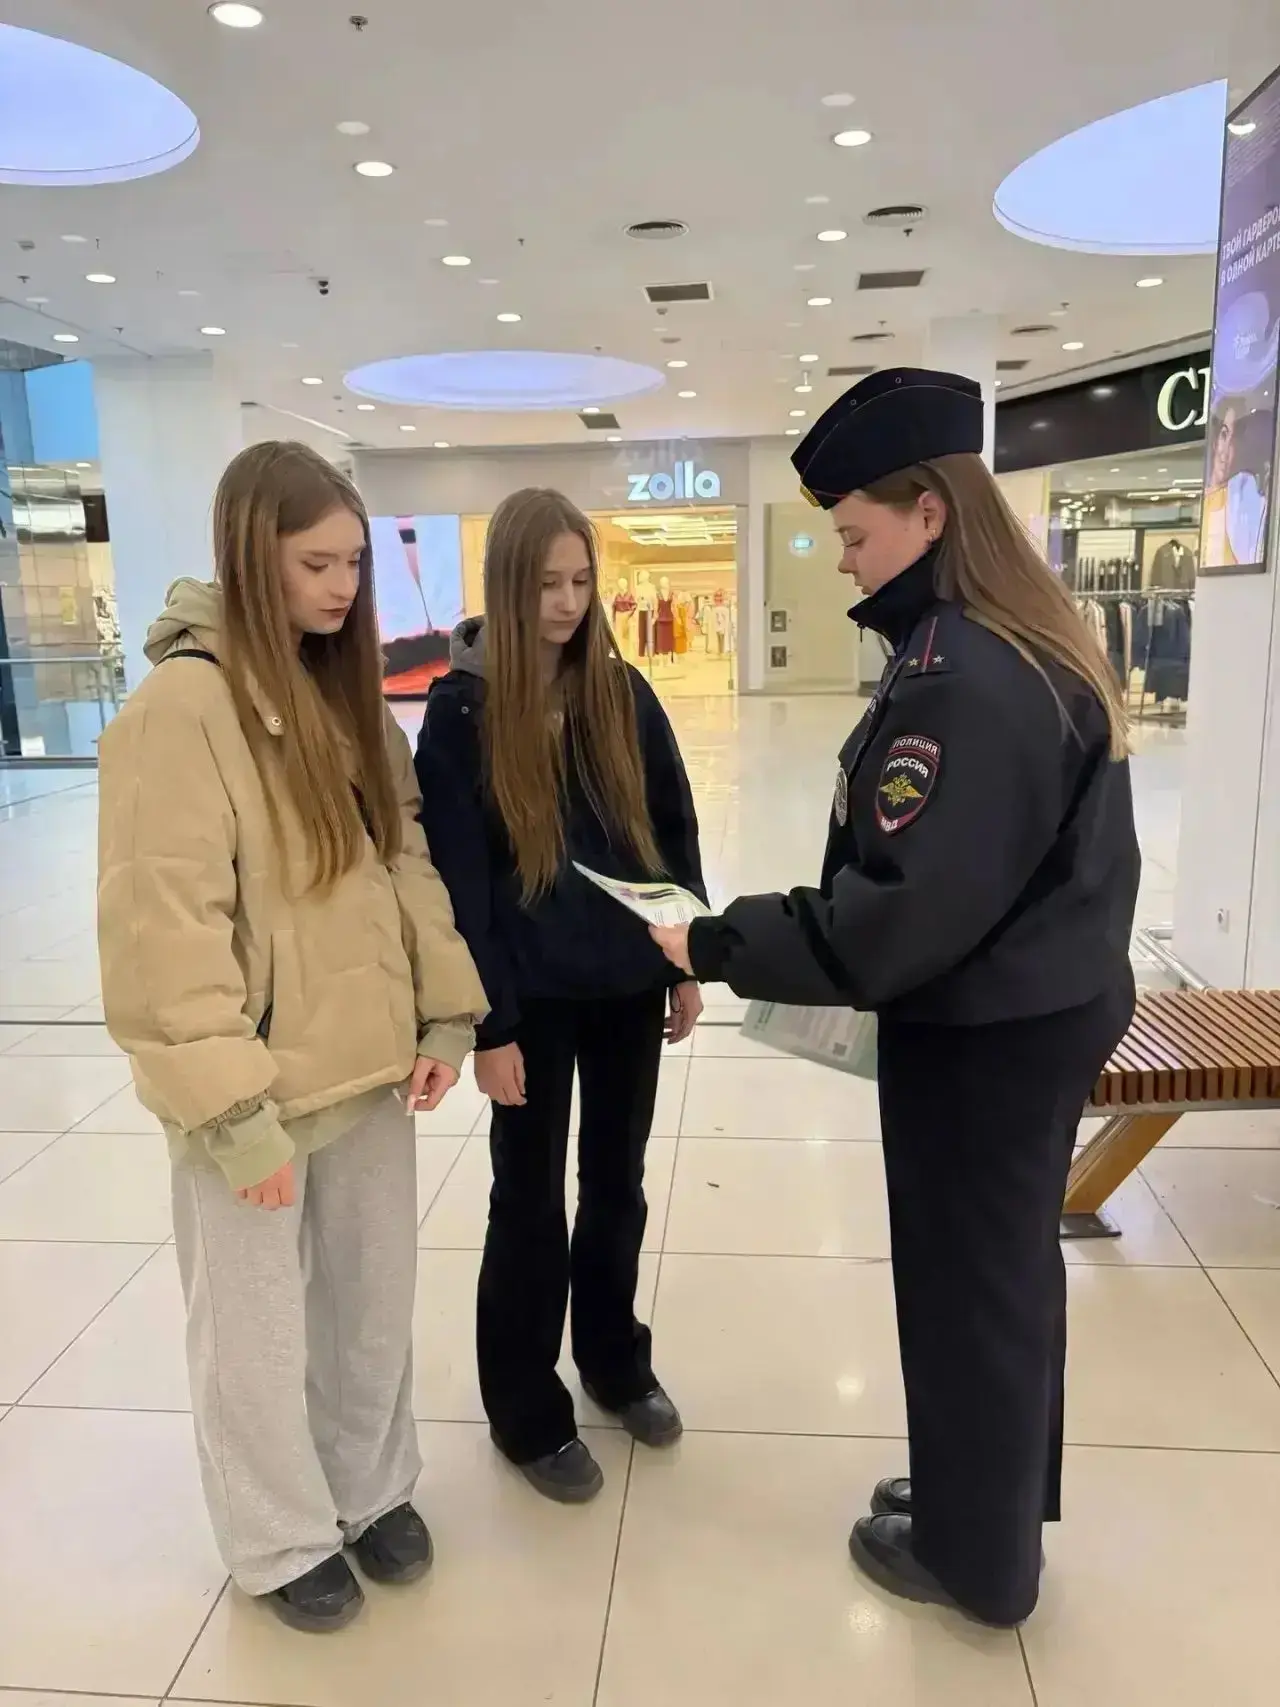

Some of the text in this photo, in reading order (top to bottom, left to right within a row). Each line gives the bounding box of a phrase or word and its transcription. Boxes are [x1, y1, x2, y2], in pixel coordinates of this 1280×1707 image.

[1222, 228, 1242, 260] ТВОЙ
[1221, 269, 1226, 288] В
[1226, 245, 1255, 283] ОДНОЙ
[627, 460, 721, 501] zolla
[893, 738, 938, 755] ПОЛИЦИЯ
[886, 757, 929, 778] РОССИЯ
[880, 816, 899, 832] МВД
